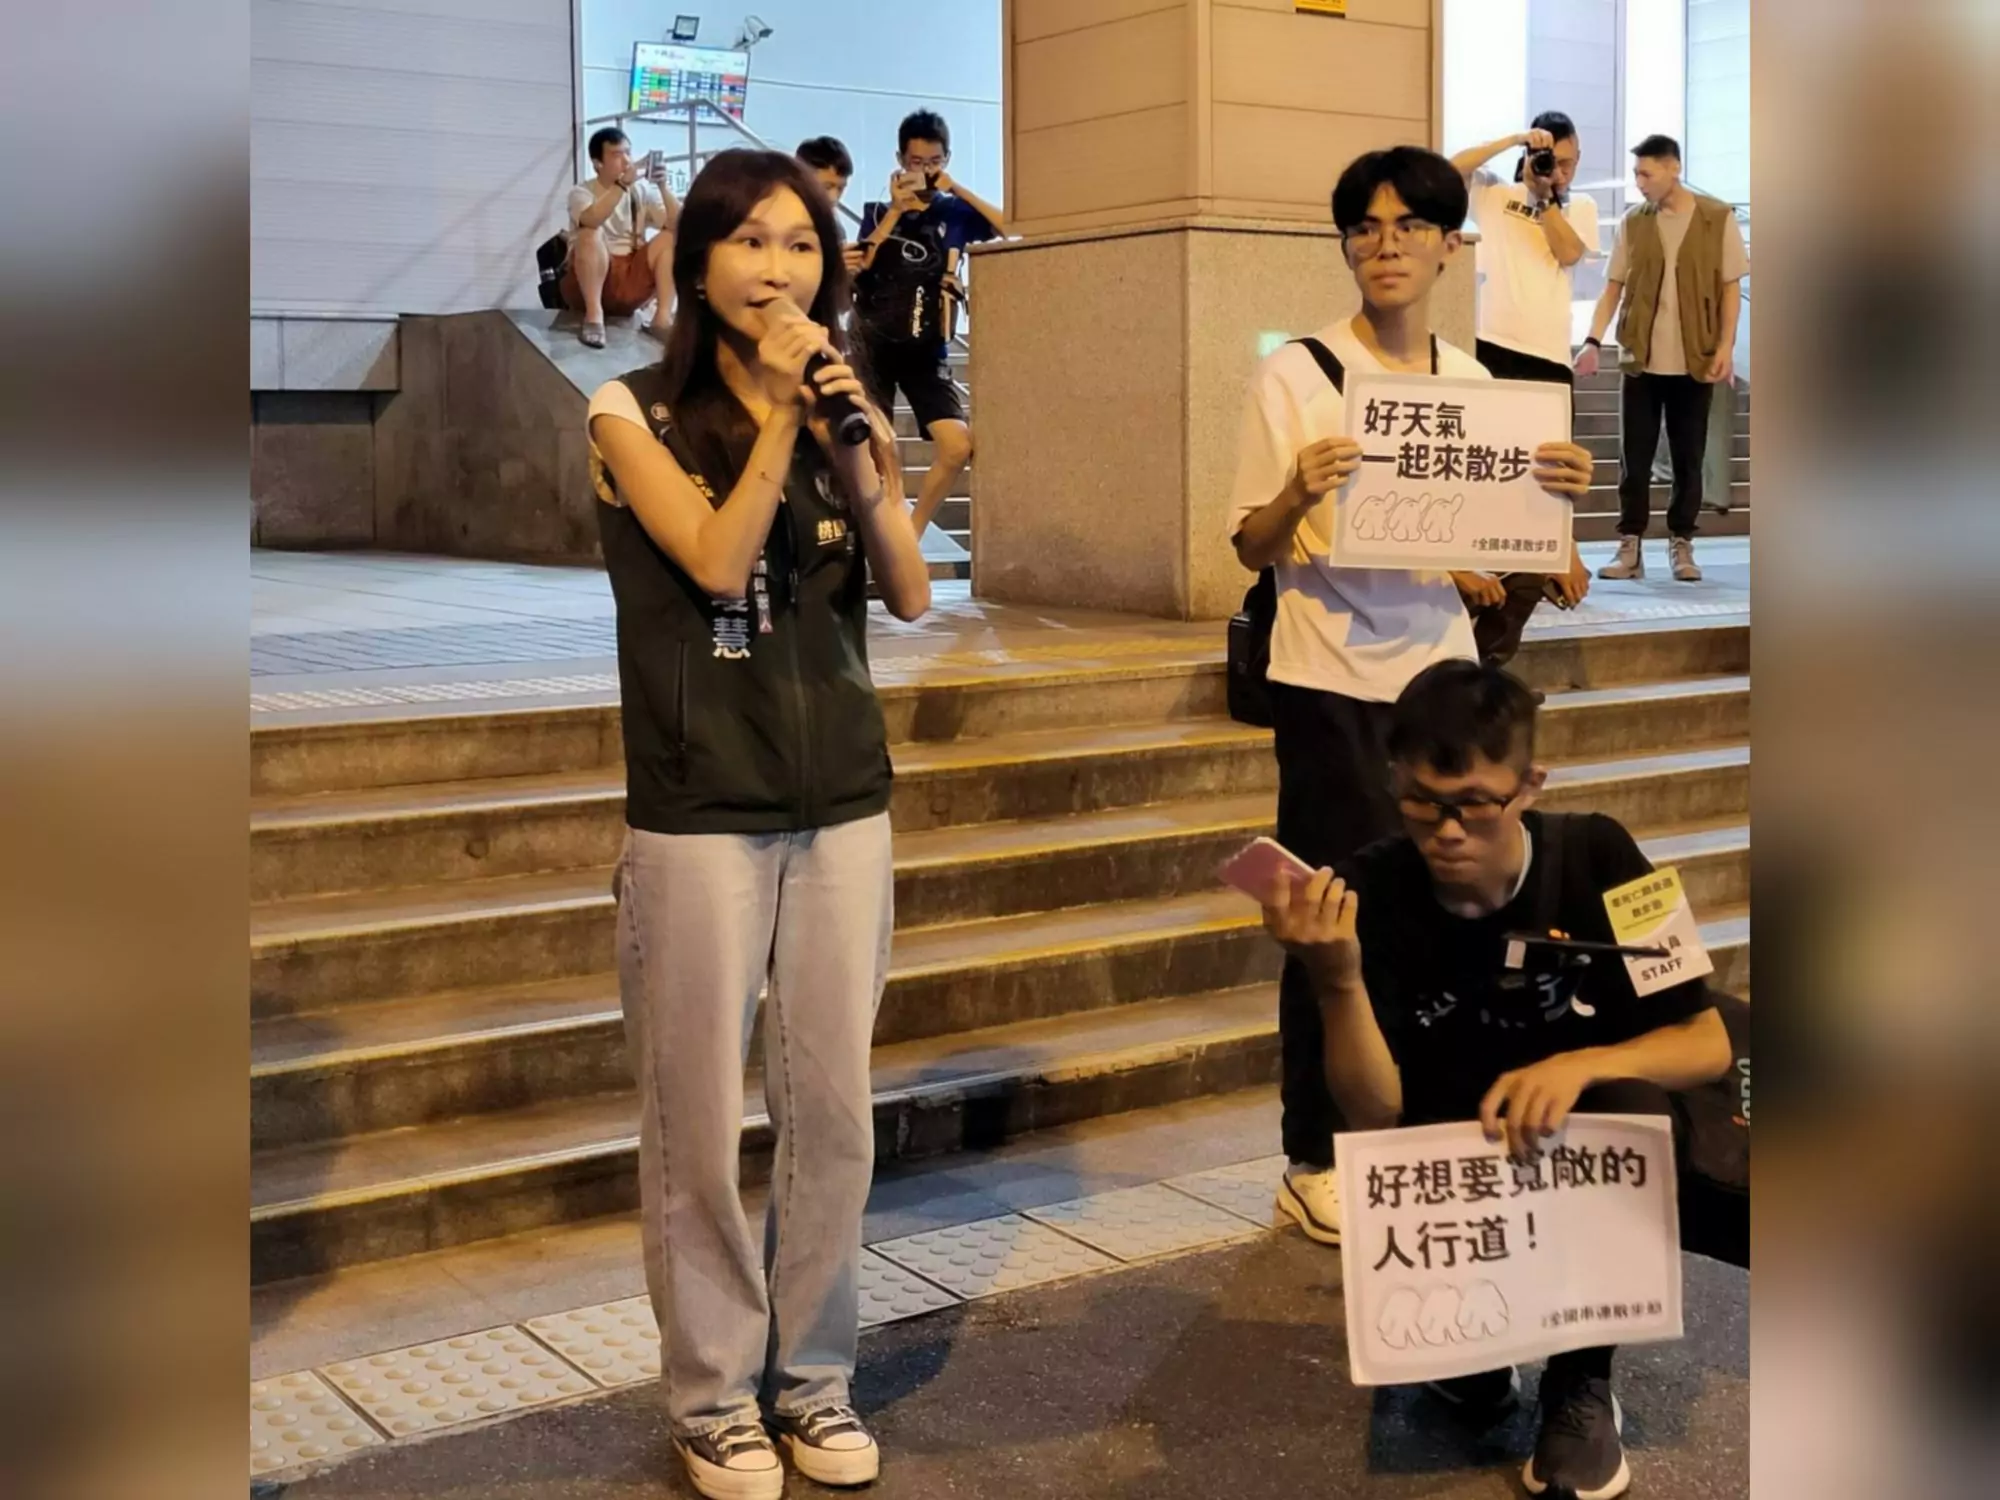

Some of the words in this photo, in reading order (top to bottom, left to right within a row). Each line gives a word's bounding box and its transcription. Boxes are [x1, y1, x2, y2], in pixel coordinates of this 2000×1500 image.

[1364, 398, 1466, 440] 好天氣
[1361, 442, 1531, 482] 一起來散步
[1641, 957, 1683, 981] STAFF
